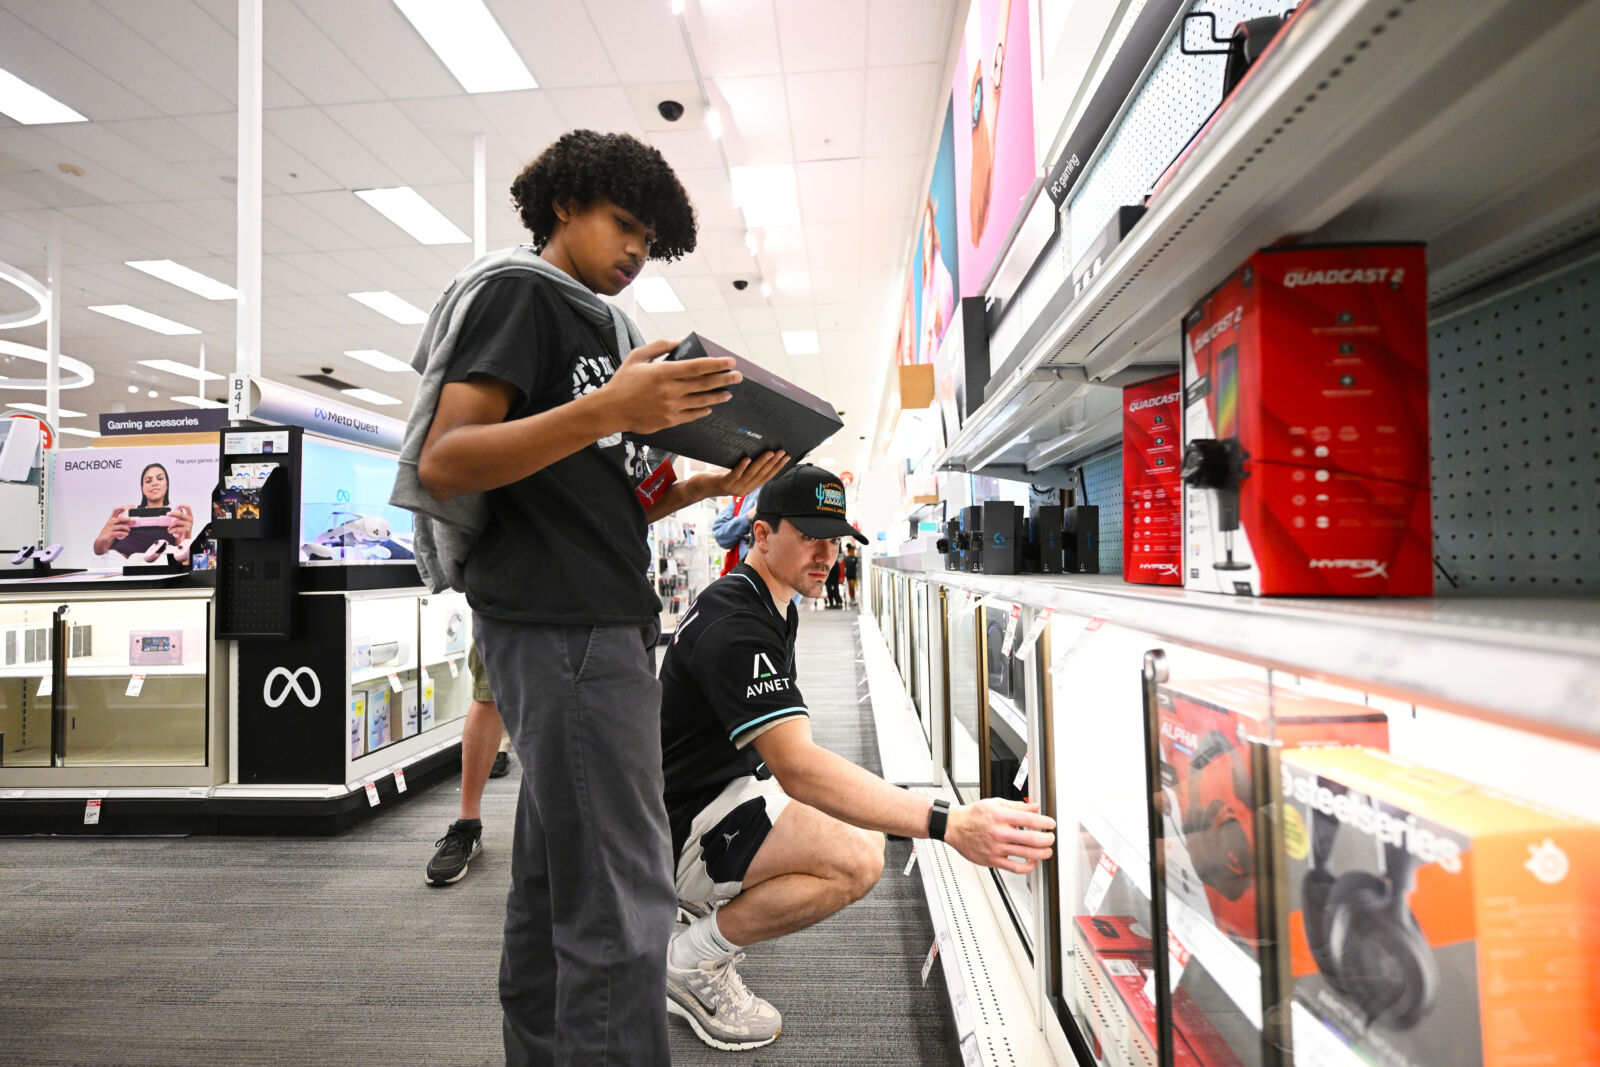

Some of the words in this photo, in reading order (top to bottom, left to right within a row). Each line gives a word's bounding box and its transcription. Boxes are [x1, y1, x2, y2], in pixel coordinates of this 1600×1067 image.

[1051, 181, 1061, 198] PC
[1059, 153, 1080, 188] gaming
[1283, 268, 1389, 288] QUADCAST
[1390, 268, 1405, 283] 2
[1129, 391, 1183, 412] QUADCAST
[107, 419, 143, 430] Gaming
[144, 416, 199, 428] accessories
[328, 411, 353, 427] Meta
[353, 418, 379, 434] Quest
[65, 460, 122, 471] BACKBONE
[746, 678, 790, 698] AVNET
[1161, 721, 1198, 750] ALPHA
[1293, 775, 1462, 874] steelseries
